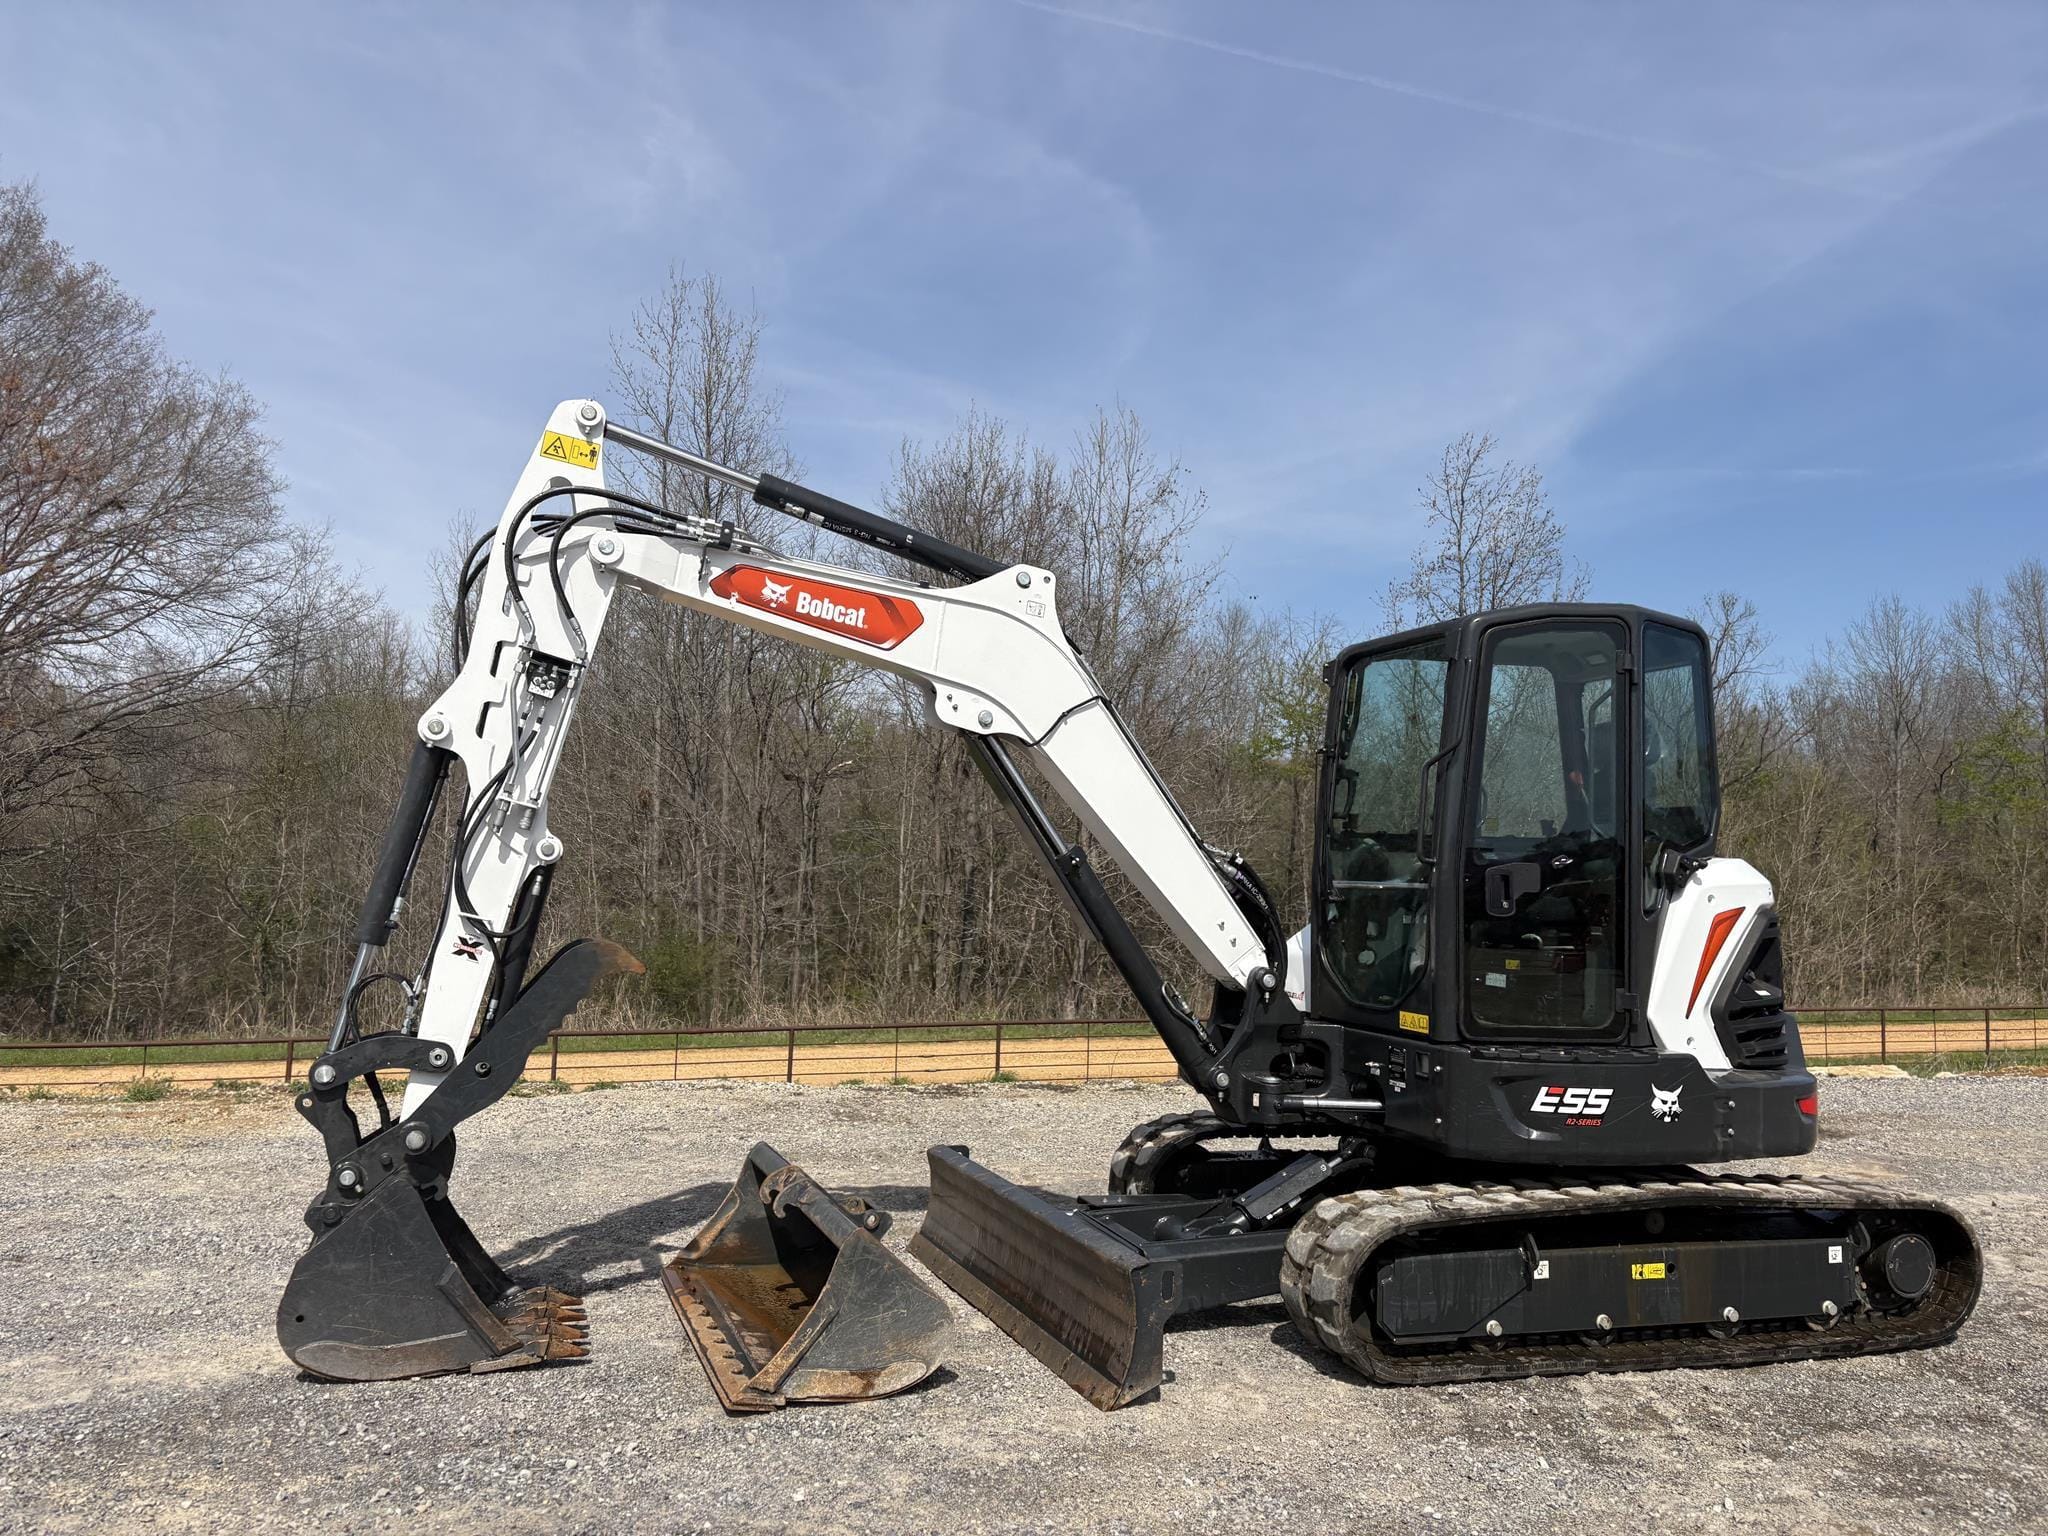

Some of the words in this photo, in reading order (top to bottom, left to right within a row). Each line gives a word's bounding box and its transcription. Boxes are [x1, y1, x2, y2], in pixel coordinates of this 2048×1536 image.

[795, 591, 866, 629] Bobcat
[1530, 1086, 1614, 1115] E55
[1566, 1118, 1602, 1126] R2-SERIES
